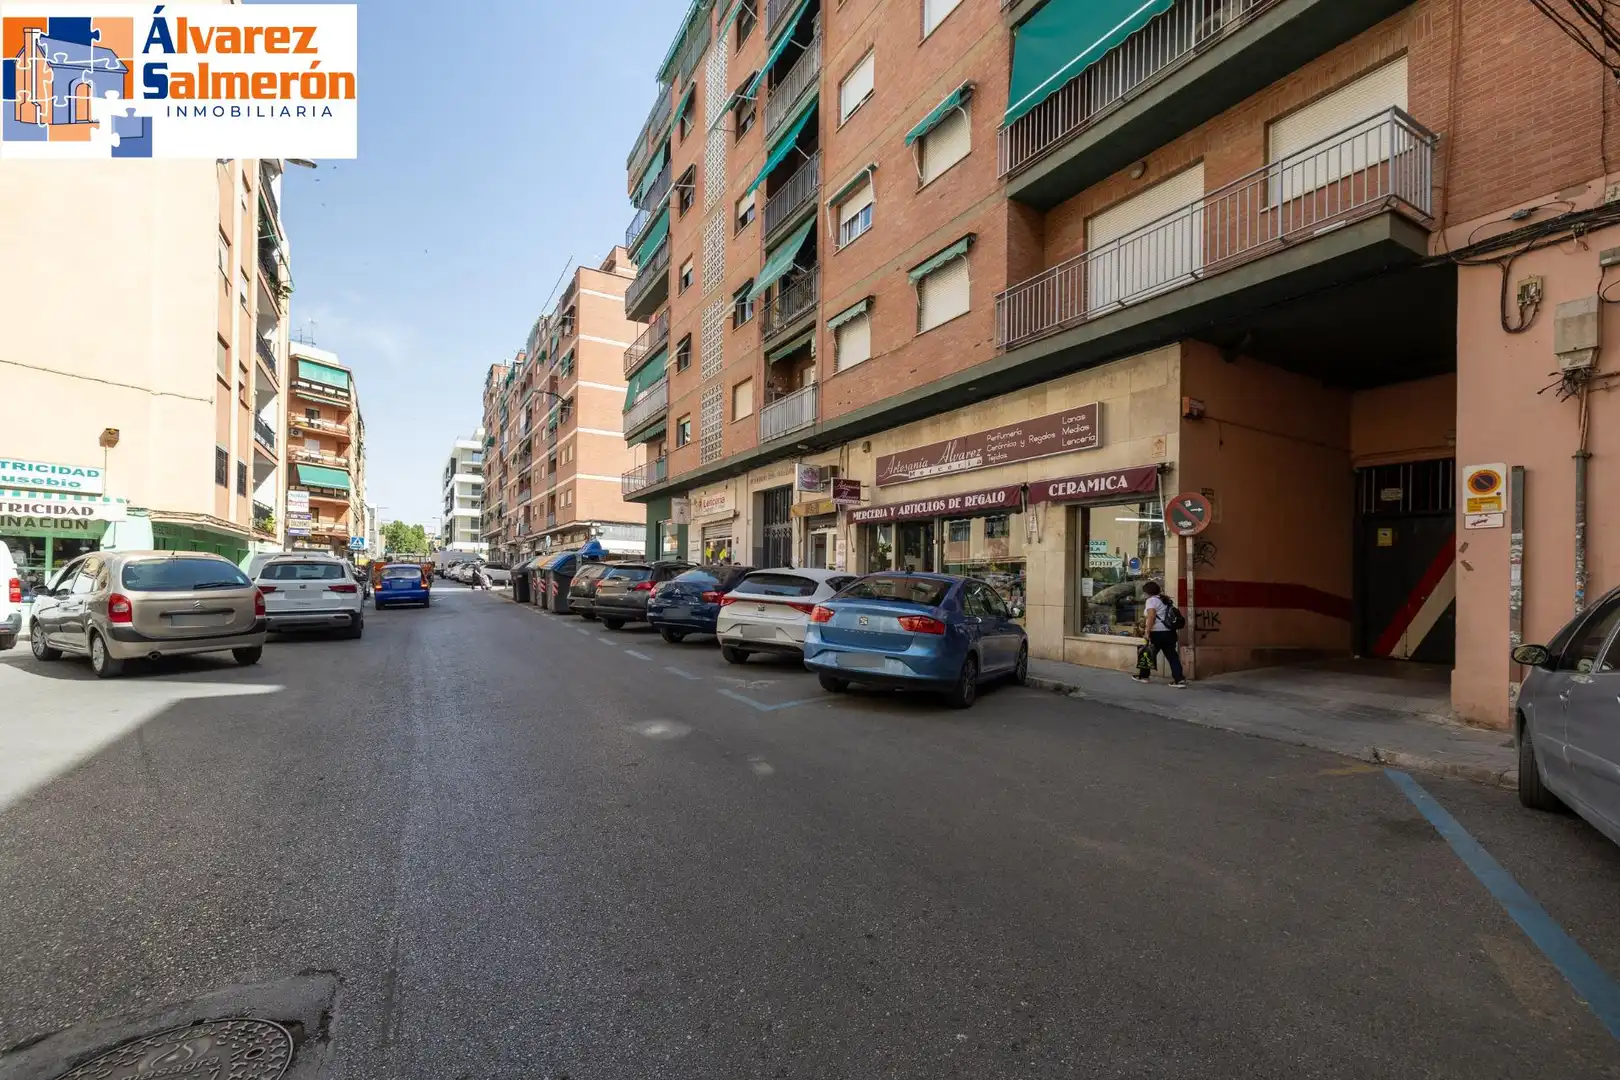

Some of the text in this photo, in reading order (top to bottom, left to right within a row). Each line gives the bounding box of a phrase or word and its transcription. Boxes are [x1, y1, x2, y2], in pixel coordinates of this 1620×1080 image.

[1062, 415, 1086, 424] Lanas
[986, 428, 1023, 441] Perfumería
[1061, 424, 1090, 435] Medias
[1029, 432, 1056, 444] Regalos
[1062, 432, 1096, 446] Lencería
[937, 439, 982, 464] Alvarez
[987, 452, 1008, 463] Tejidos
[0, 461, 100, 478] TRICIDAD
[1048, 475, 1128, 496] CERAMICA
[853, 490, 1006, 520] MERCERIA Y ARTICULOS DE REGALO
